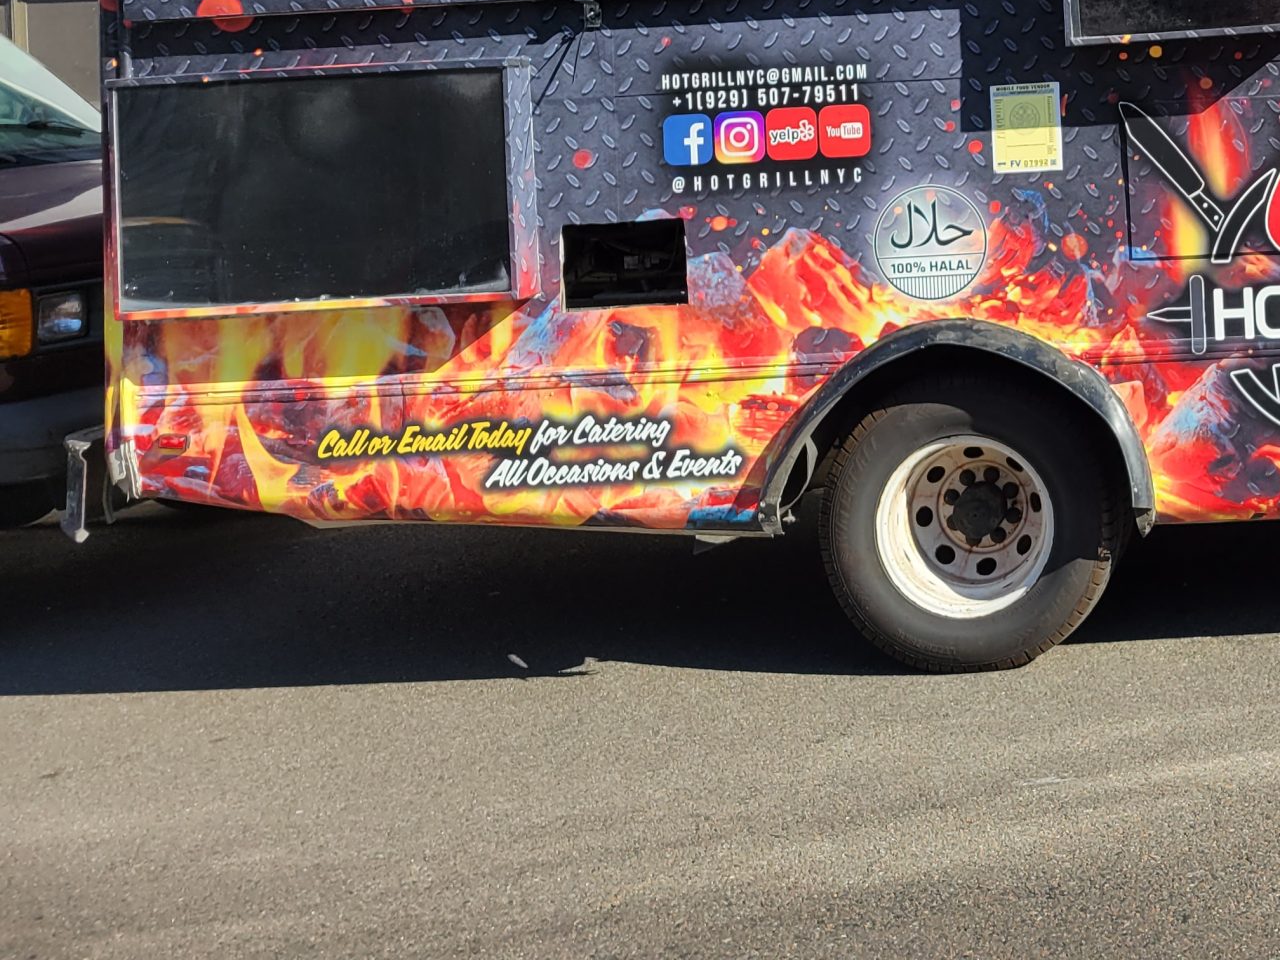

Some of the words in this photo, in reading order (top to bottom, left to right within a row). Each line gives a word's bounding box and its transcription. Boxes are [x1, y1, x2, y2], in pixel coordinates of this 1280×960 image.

[661, 64, 868, 90] HOTGRILLNYC@GMAIL.COM
[672, 89, 749, 110] +1(929)
[757, 83, 859, 107] 507-79511
[769, 125, 801, 145] yelp
[1010, 159, 1021, 168] FV
[891, 200, 974, 249] حلال
[891, 261, 926, 274] 100%
[929, 259, 973, 272] HALAL
[318, 429, 370, 459] Call
[368, 435, 397, 456] or
[397, 423, 469, 454] Email
[468, 421, 532, 455] Today
[529, 419, 574, 454] for
[573, 415, 671, 447] Catering
[485, 458, 528, 488] All
[526, 456, 640, 487] Occasions
[642, 450, 666, 480] &
[666, 449, 742, 479] Events
